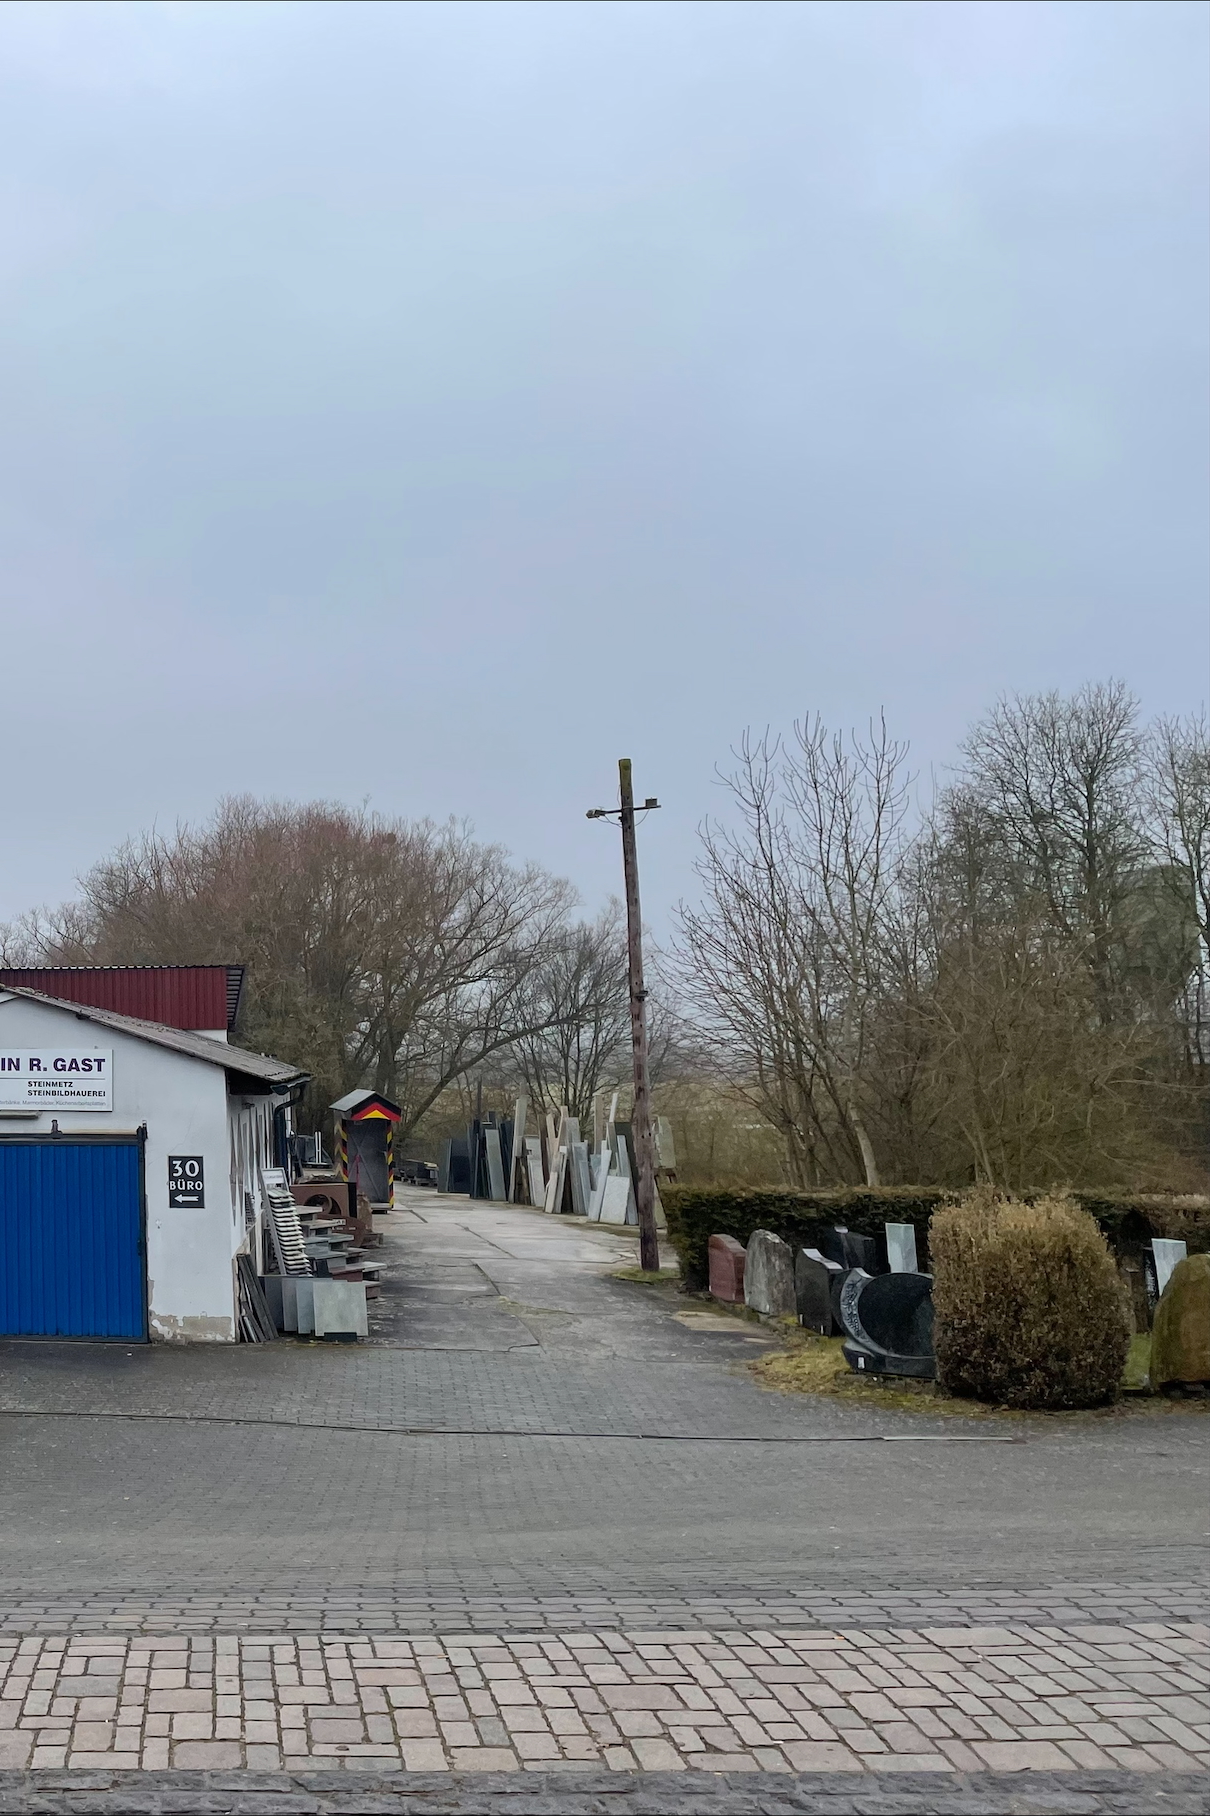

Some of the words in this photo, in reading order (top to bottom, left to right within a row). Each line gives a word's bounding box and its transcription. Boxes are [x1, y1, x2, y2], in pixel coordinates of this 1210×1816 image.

[28, 1057, 48, 1072] R.
[53, 1057, 106, 1072] GAST
[27, 1089, 106, 1097] STEINBILDHAUEREI
[172, 1160, 199, 1177] 30
[170, 1179, 203, 1190] BÜRO
